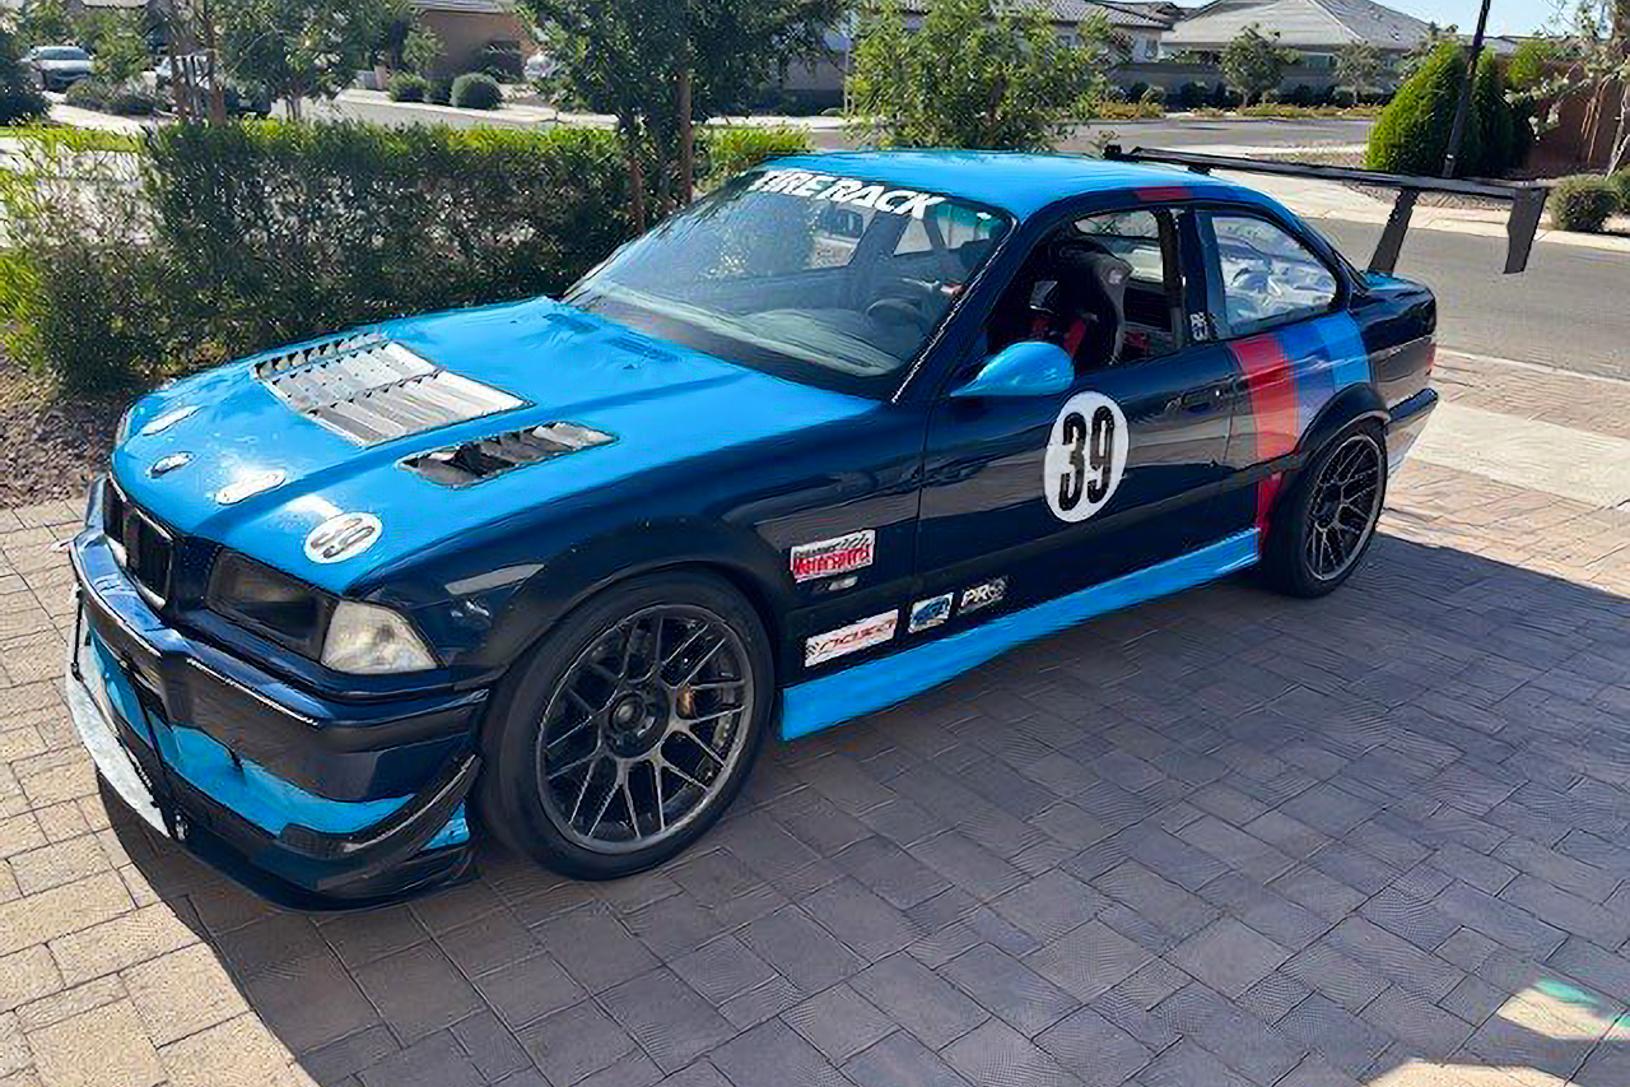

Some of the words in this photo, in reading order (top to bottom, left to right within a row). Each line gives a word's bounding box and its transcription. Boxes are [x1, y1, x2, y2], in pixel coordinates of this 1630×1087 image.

[748, 168, 836, 197] TIRE
[815, 179, 946, 220] RACK
[1058, 405, 1115, 511] 39
